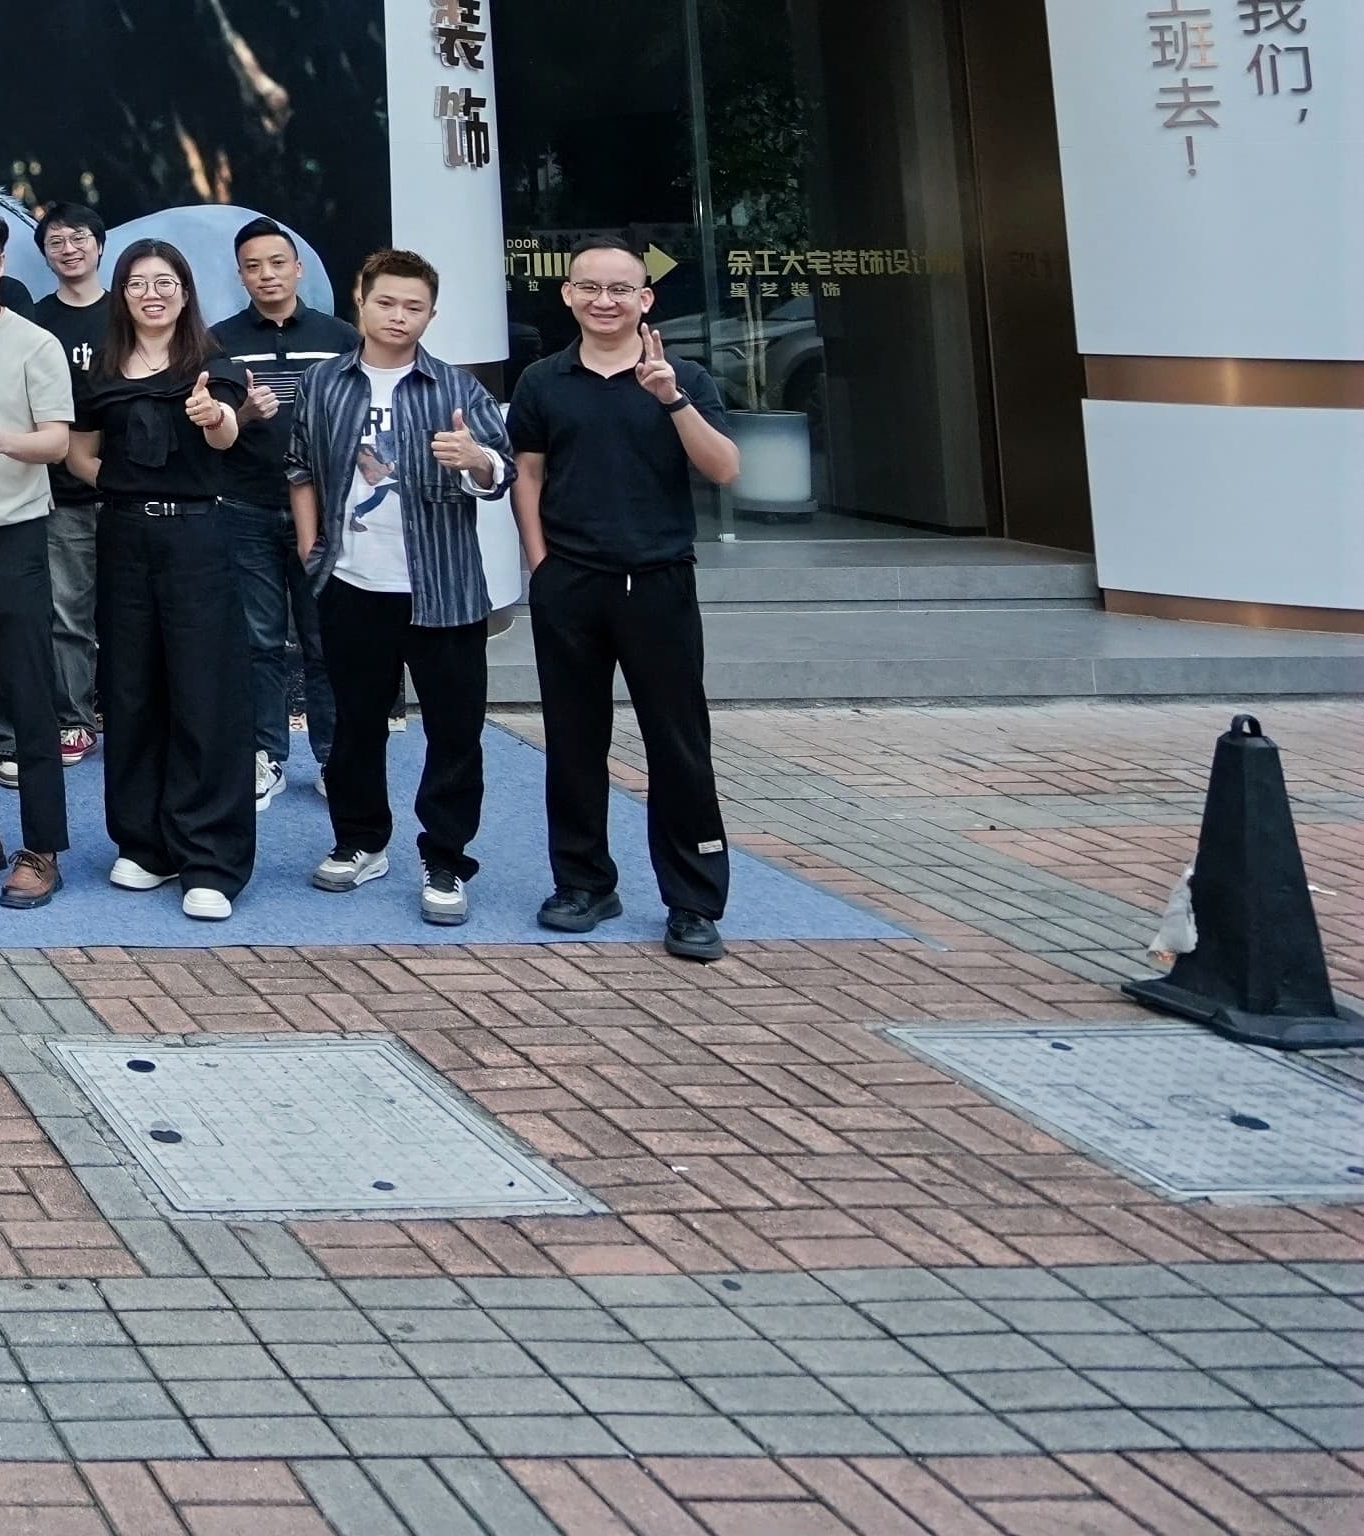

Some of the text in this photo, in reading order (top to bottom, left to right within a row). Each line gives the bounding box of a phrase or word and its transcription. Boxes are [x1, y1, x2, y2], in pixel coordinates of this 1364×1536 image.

[506, 239, 539, 249] DOOR
[730, 282, 841, 297] 星艺装饰
